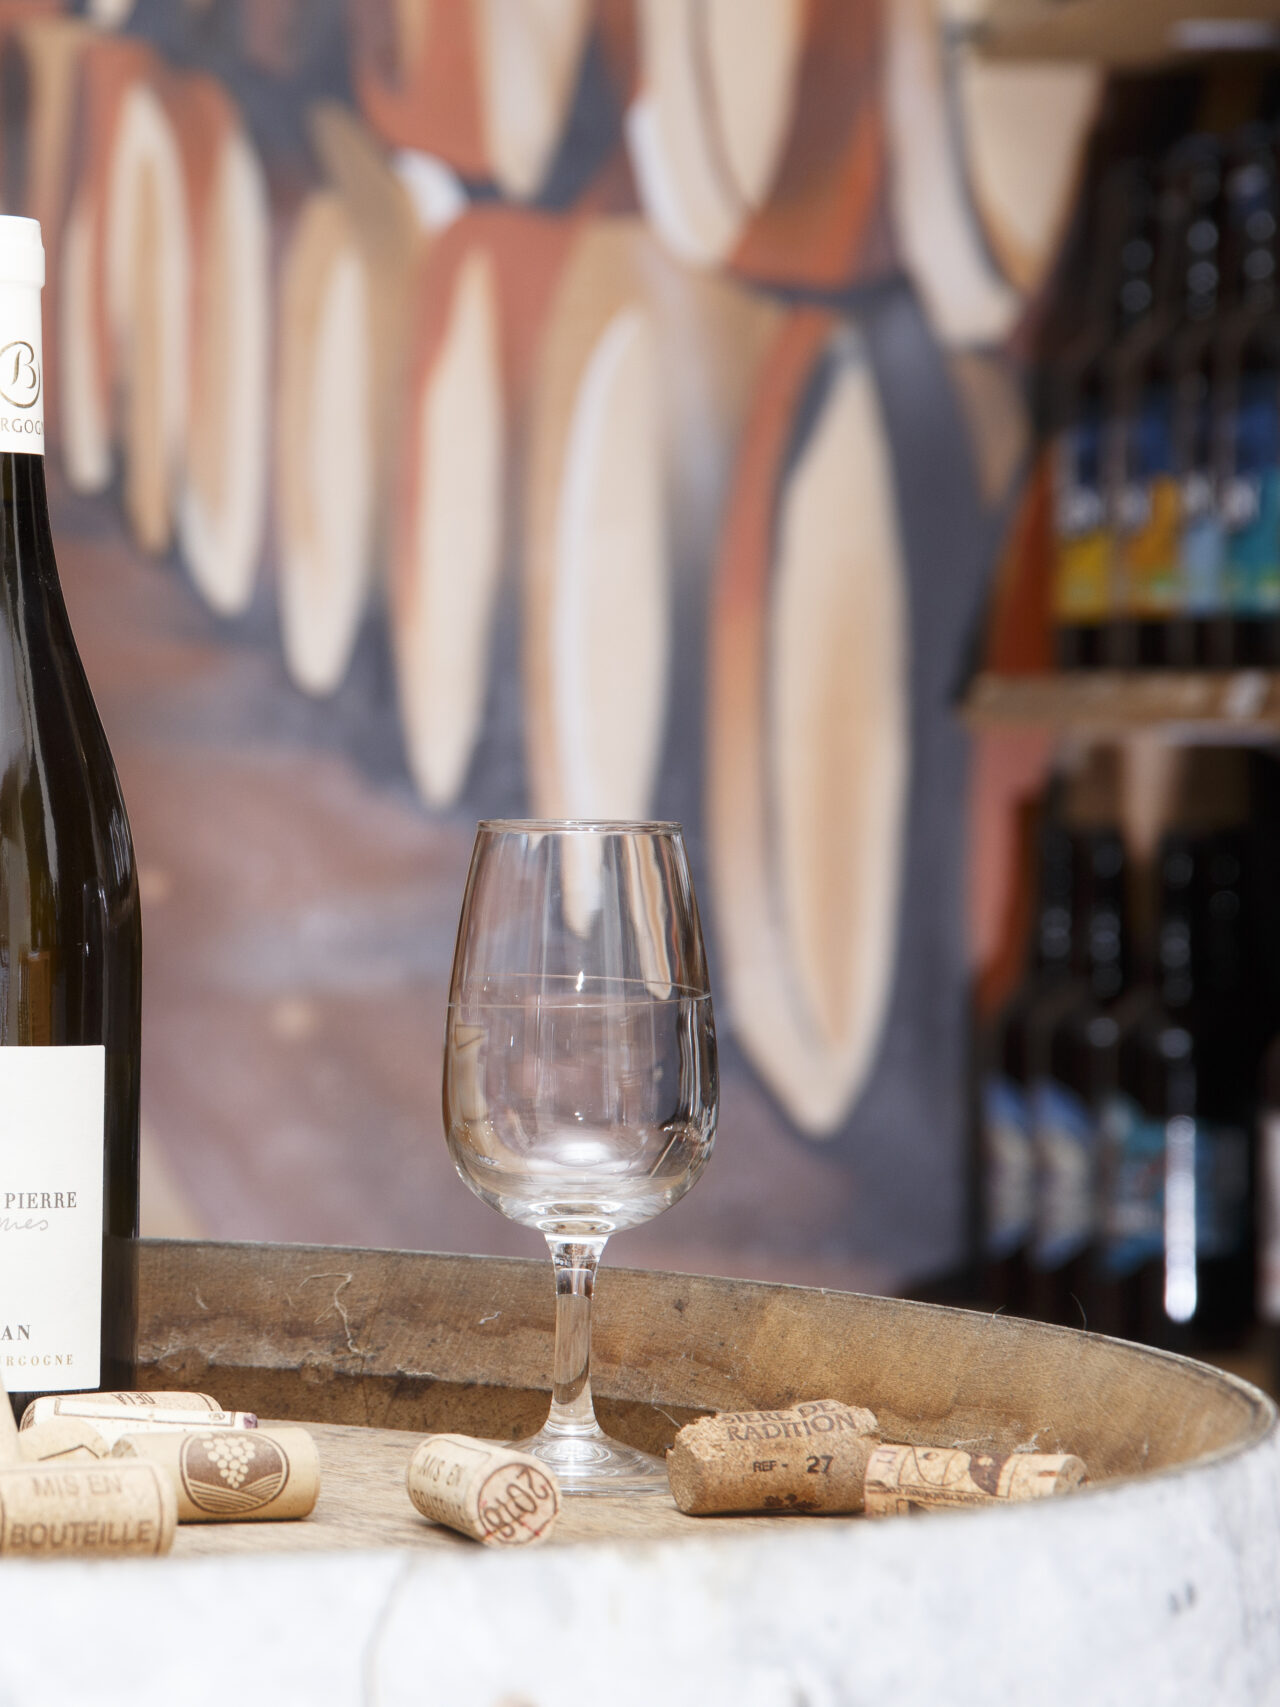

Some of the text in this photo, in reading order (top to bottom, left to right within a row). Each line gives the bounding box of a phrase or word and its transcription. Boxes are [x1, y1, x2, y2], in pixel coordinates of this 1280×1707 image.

[5, 1191, 78, 1209] PIERRE
[797, 1400, 836, 1418] DE
[726, 1411, 857, 1441] RADITION
[752, 1460, 777, 1473] REF
[806, 1454, 834, 1474] 27
[483, 1466, 550, 1539] 2018
[9, 1518, 153, 1549] BOUTEILLE
